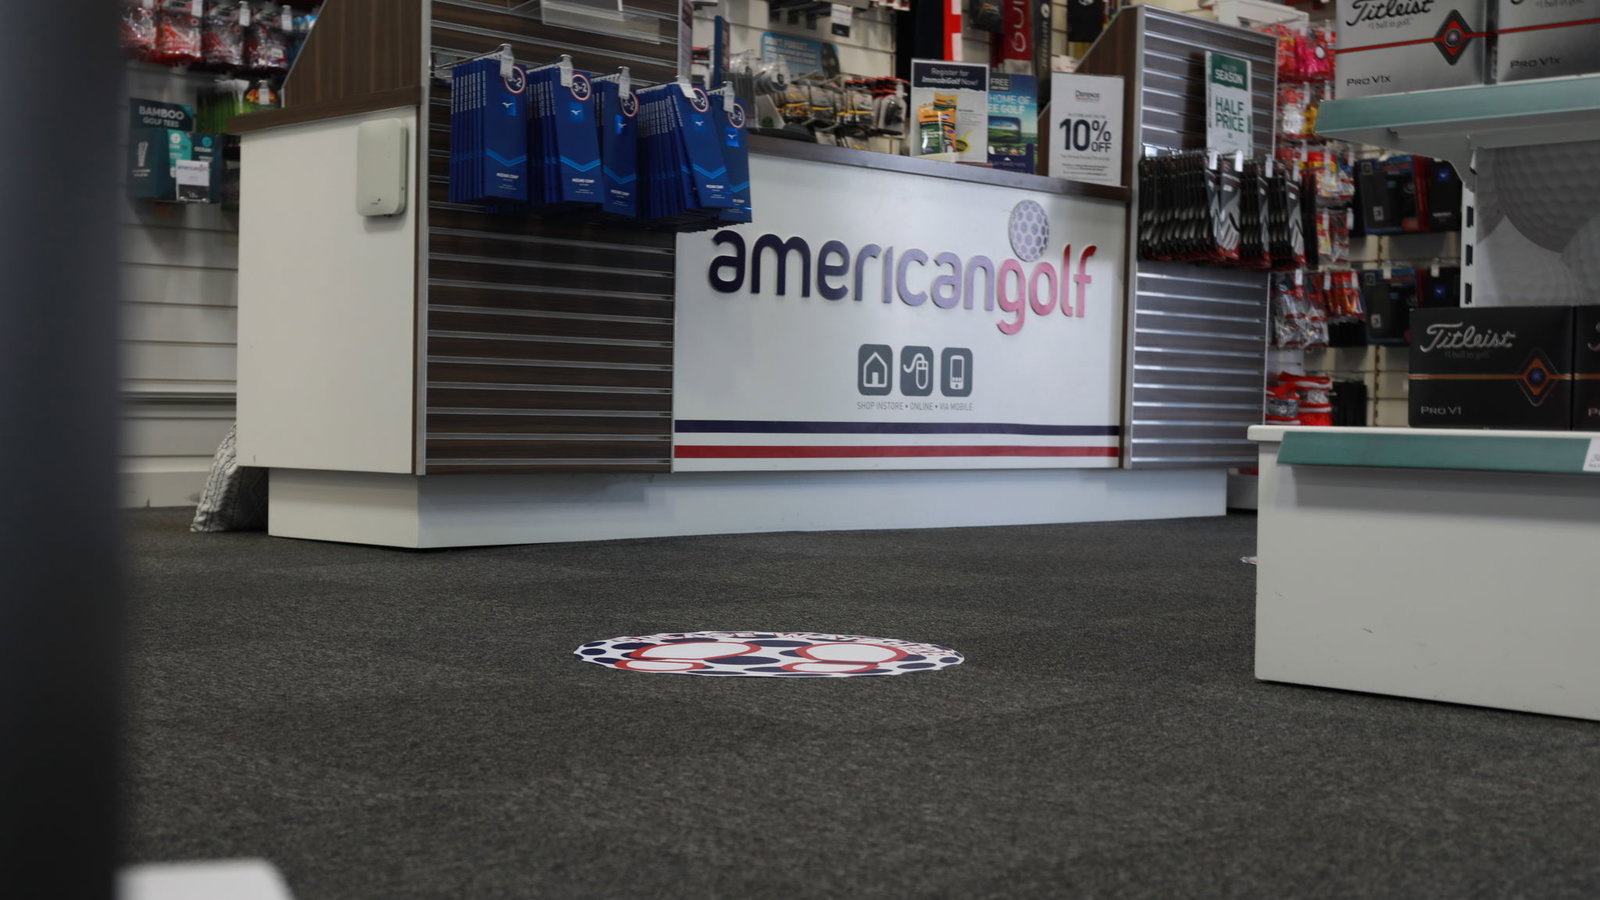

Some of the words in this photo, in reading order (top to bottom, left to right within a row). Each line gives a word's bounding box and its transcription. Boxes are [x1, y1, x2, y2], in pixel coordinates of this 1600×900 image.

[1345, 0, 1434, 27] Titleist
[990, 77, 1009, 87] FREE
[1215, 68, 1244, 85] SEASON
[1346, 77, 1371, 87] PRO
[989, 93, 1017, 104] HOME
[1018, 95, 1032, 105] OF
[139, 105, 185, 120] BAMBOO
[1001, 104, 1026, 114] GOLF
[1215, 96, 1245, 117] HALF
[142, 116, 162, 126] GOLF
[163, 119, 180, 128] TEES
[1215, 111, 1245, 133] PRICE
[1091, 141, 1112, 153] OFF
[1420, 321, 1517, 353] Titleist
[857, 401, 875, 410] SHOP
[876, 401, 904, 411] INSTORE
[910, 402, 934, 411] ONLINE
[939, 402, 949, 411] VIA
[950, 402, 974, 412] MOBILE
[1420, 405, 1447, 415] PRO
[1448, 406, 1462, 415] V1
